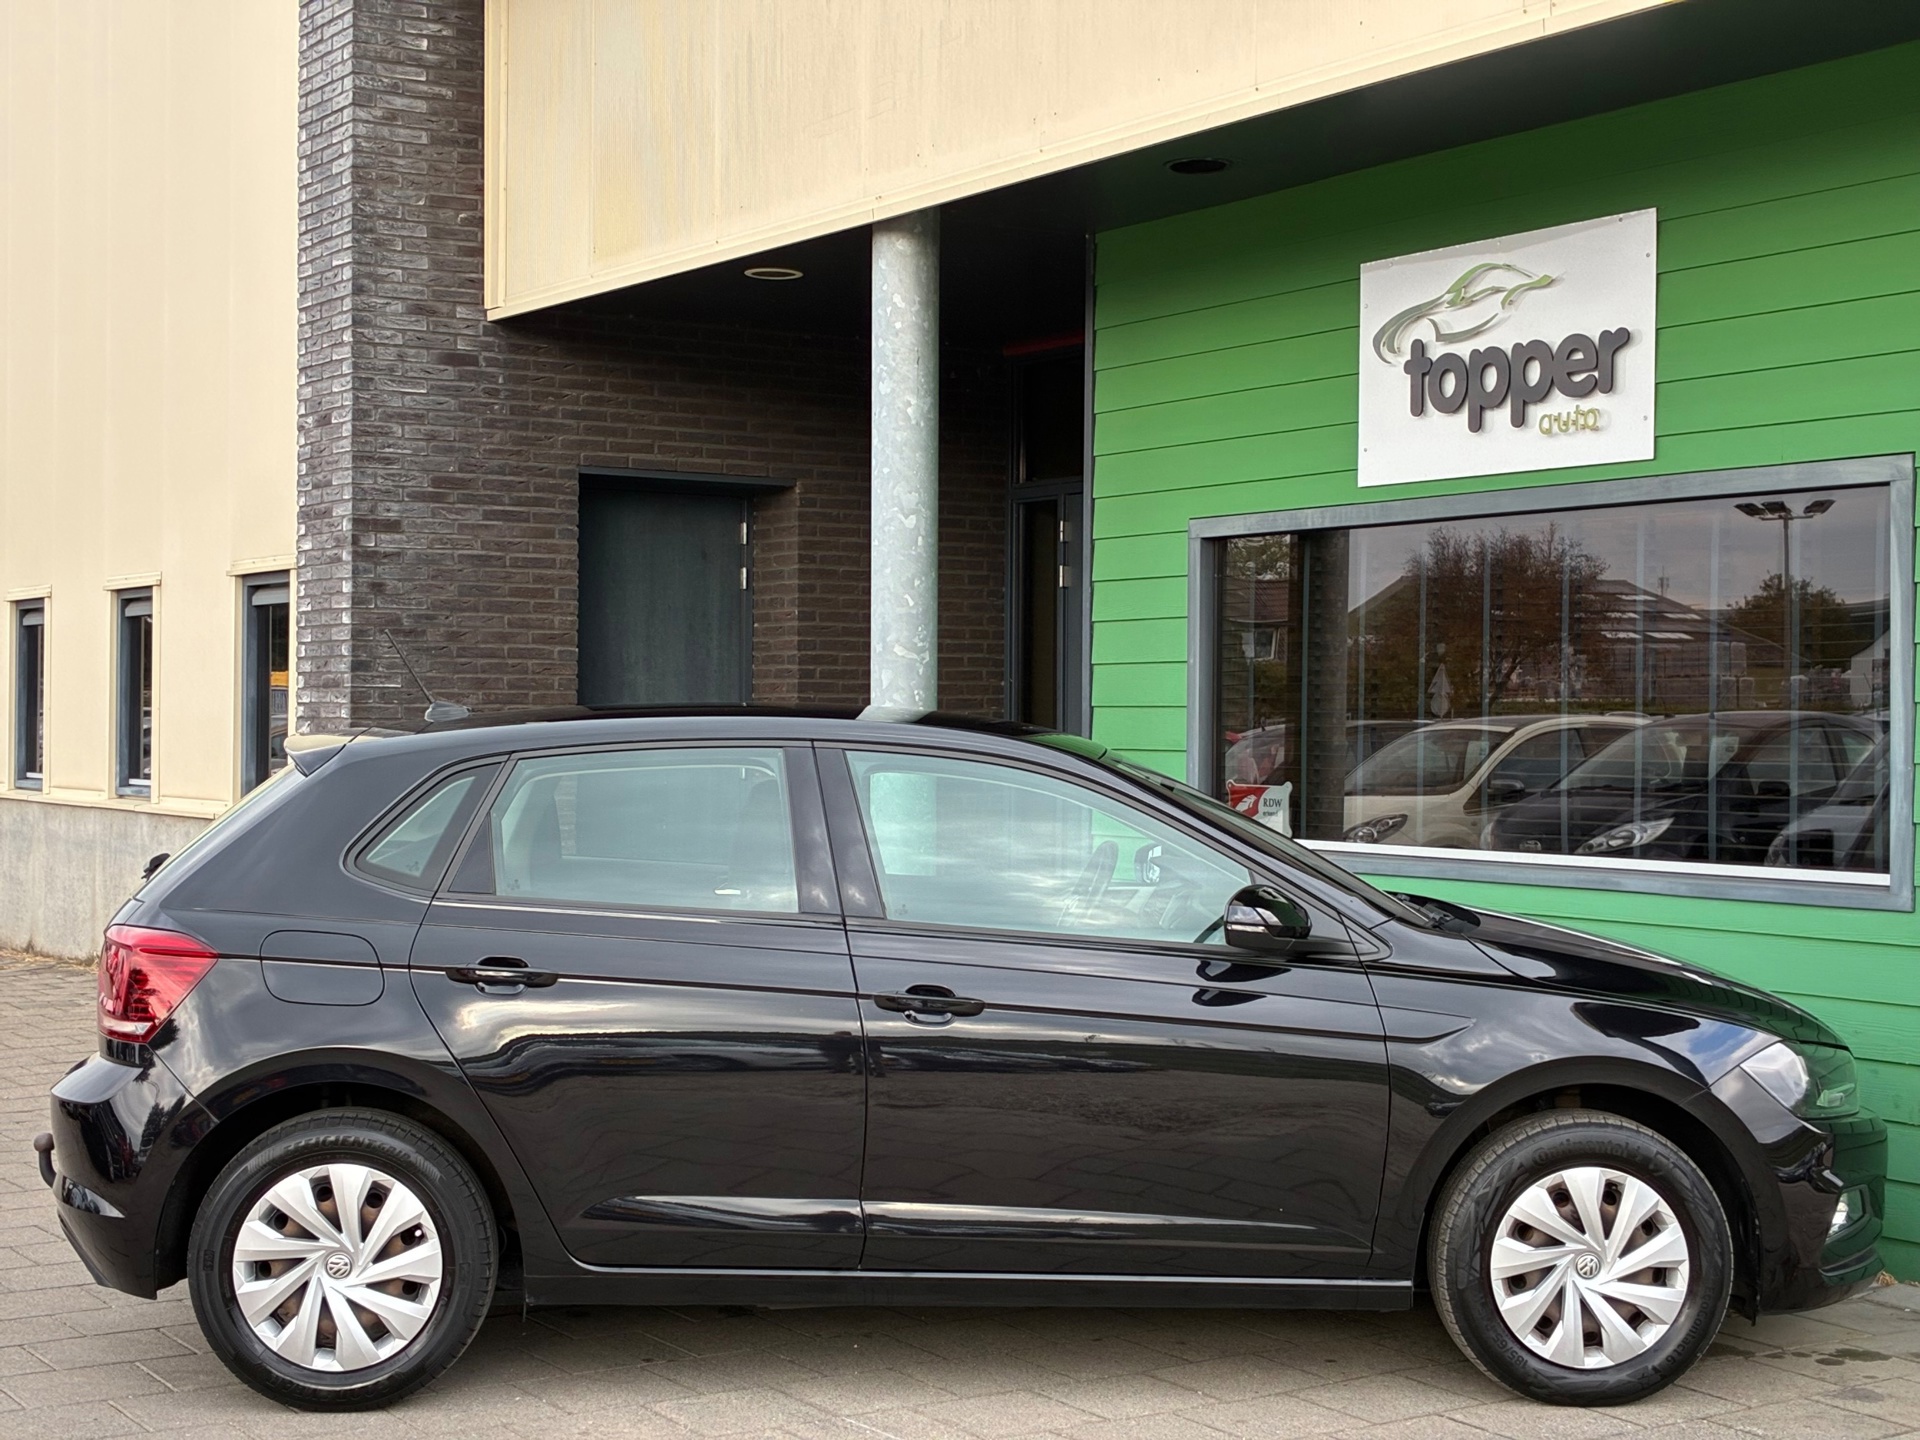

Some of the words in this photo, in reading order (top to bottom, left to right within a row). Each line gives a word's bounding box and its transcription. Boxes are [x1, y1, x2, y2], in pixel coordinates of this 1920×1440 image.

[1404, 327, 1630, 433] topper
[1539, 405, 1600, 436] auto
[1263, 797, 1283, 807] RDW
[1492, 1333, 1529, 1369] 185/65
